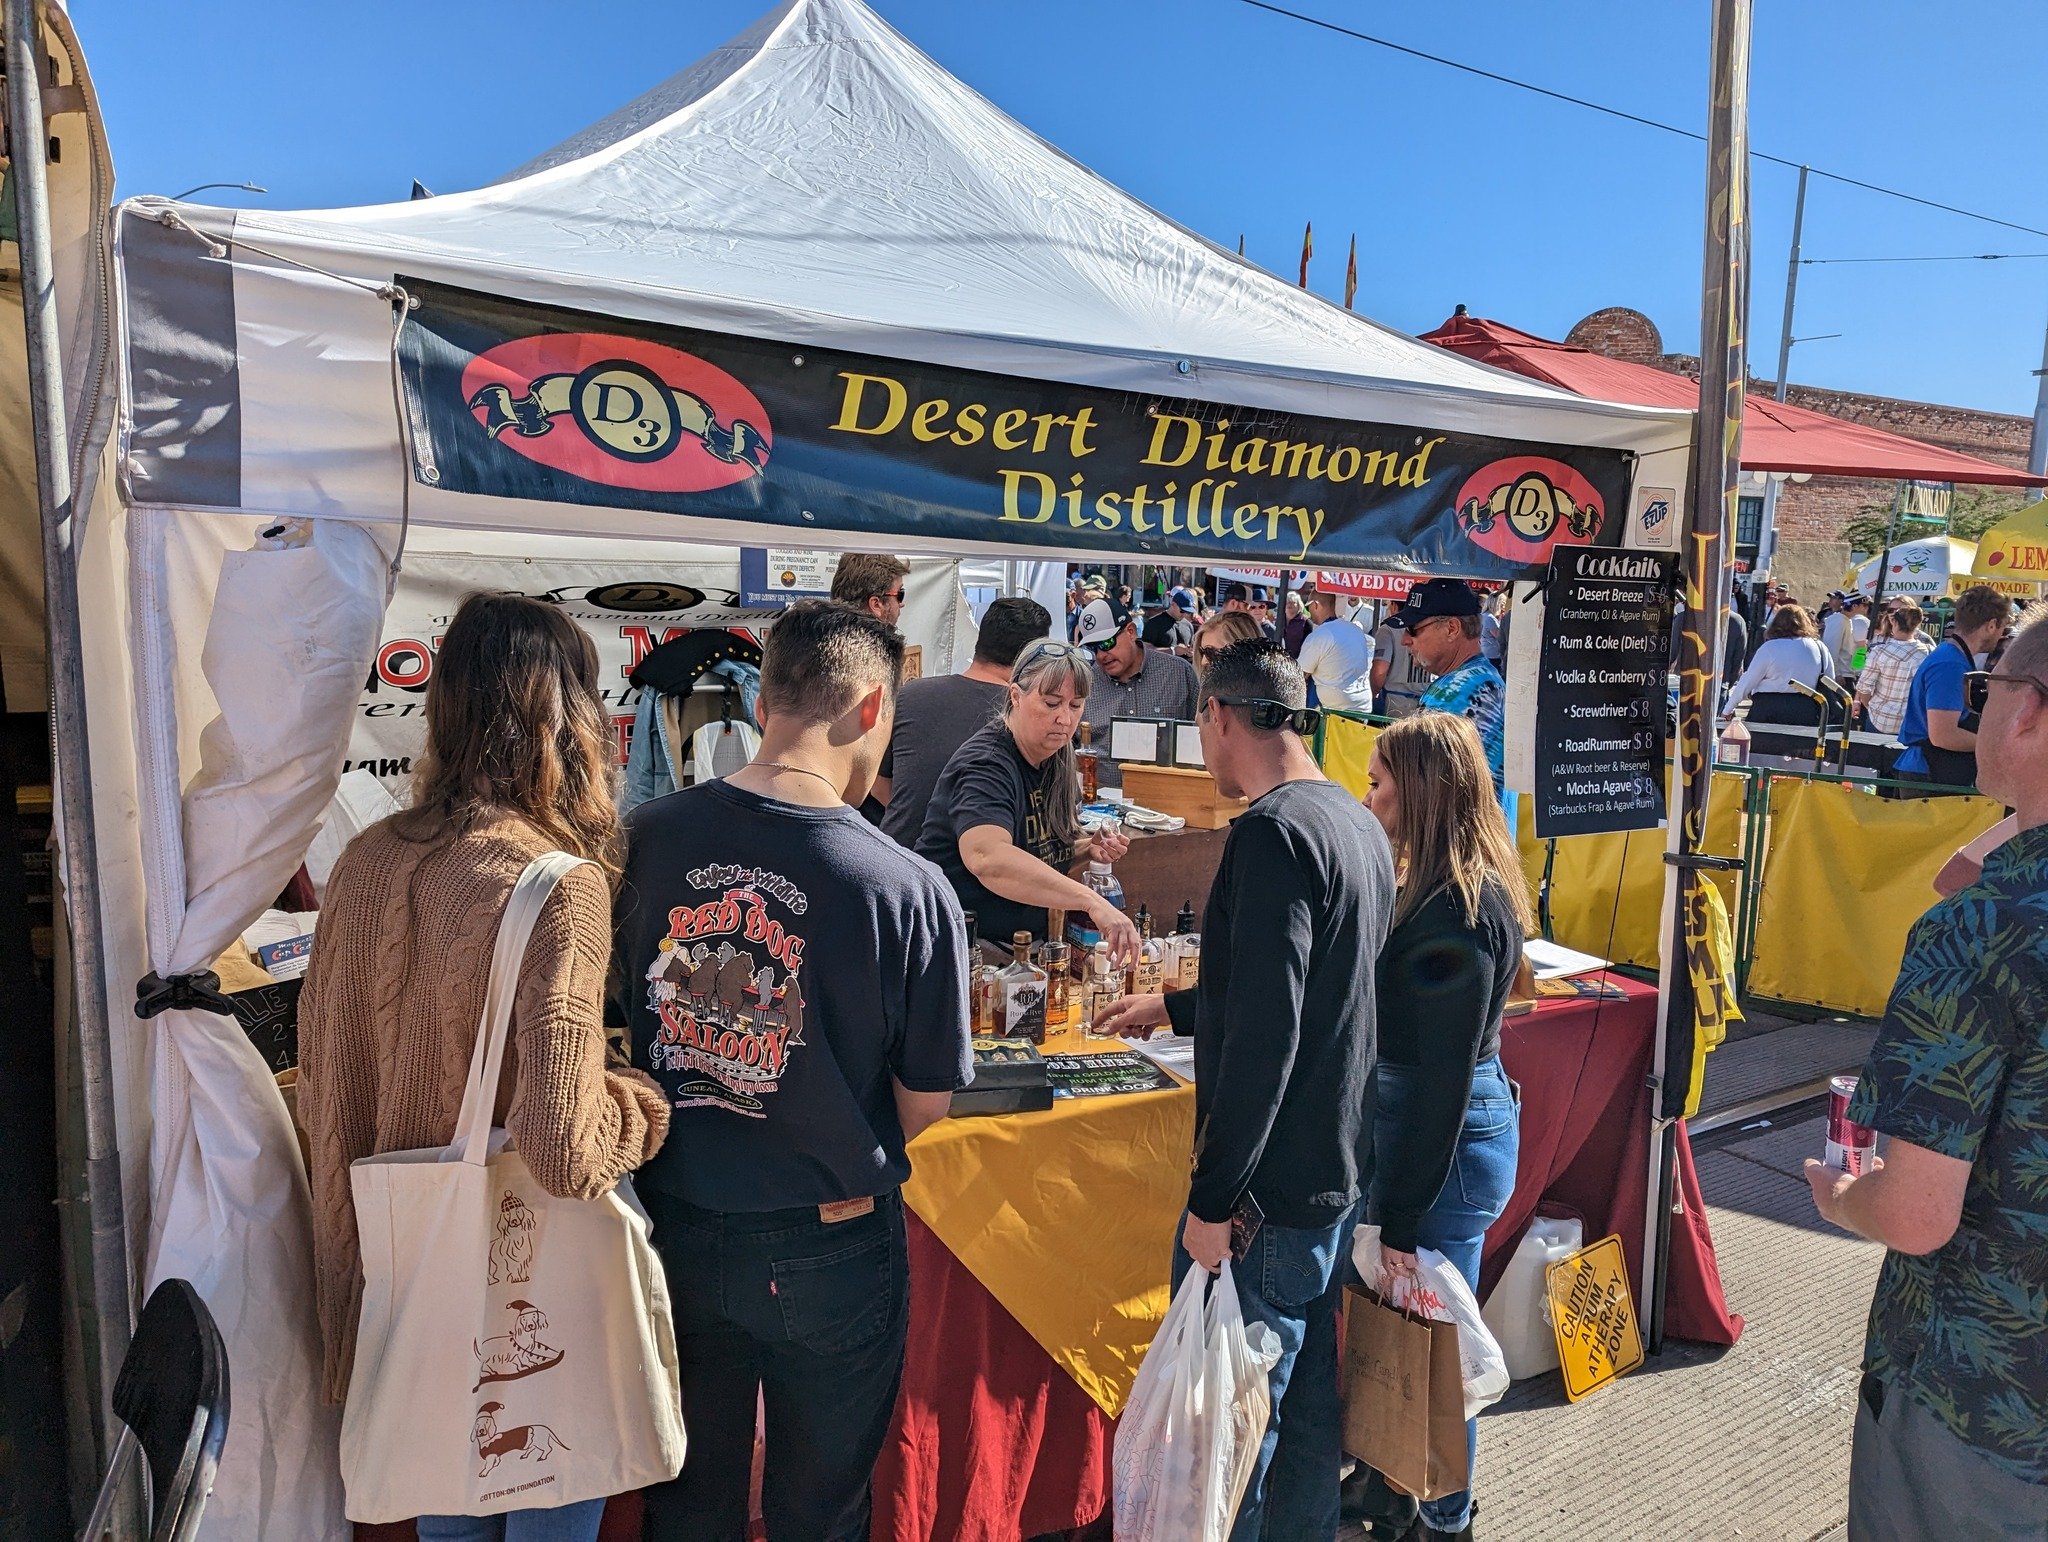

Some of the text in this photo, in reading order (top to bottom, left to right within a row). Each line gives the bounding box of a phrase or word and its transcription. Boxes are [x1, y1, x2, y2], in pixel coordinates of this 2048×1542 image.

[827, 371, 1446, 489] Desert Diamond
[997, 469, 1325, 561] Distillery
[1576, 553, 1662, 578] Cocktails
[1320, 571, 1414, 592] SHAVED ICE
[1883, 581, 1939, 592] LEMONADE
[1577, 587, 1610, 601] Desert
[1612, 588, 1644, 602] Breeze
[696, 609, 783, 621] Distill
[1560, 607, 1660, 622] (Cranberry, OJ & Agave Rum)
[1559, 635, 1583, 649] Rum
[1584, 635, 1593, 649] &
[1595, 635, 1619, 649] Coke
[1621, 635, 1648, 652] (Diet)
[1555, 669, 1586, 684] Vodka
[1589, 669, 1597, 683] &
[1599, 669, 1647, 686] Cranberry
[1570, 703, 1628, 718] Screwdriver
[1565, 738, 1631, 752] RoadRummer
[1552, 759, 1650, 777] (A&W Root beer & Reserve)
[1566, 781, 1600, 796] Mocha
[1602, 780, 1631, 796] Agave
[1548, 797, 1655, 818] (Starbucks Frap & Agave Rum)
[686, 863, 740, 889] Enjoy
[753, 867, 808, 915] Wildlife
[739, 891, 753, 900] THE
[667, 900, 806, 972] RED DOG
[273, 1023, 288, 1042] 2
[659, 1000, 791, 1073] SALOON
[276, 1050, 290, 1068] 4
[755, 1080, 779, 1093] doors
[1071, 1082, 1159, 1094] DRINK LOCAL
[724, 1092, 759, 1107] ALASKA
[1561, 1258, 1594, 1339] CAUTION
[1606, 1306, 1629, 1366] ZONE
[517, 1475, 555, 1493] FOUNDATION
